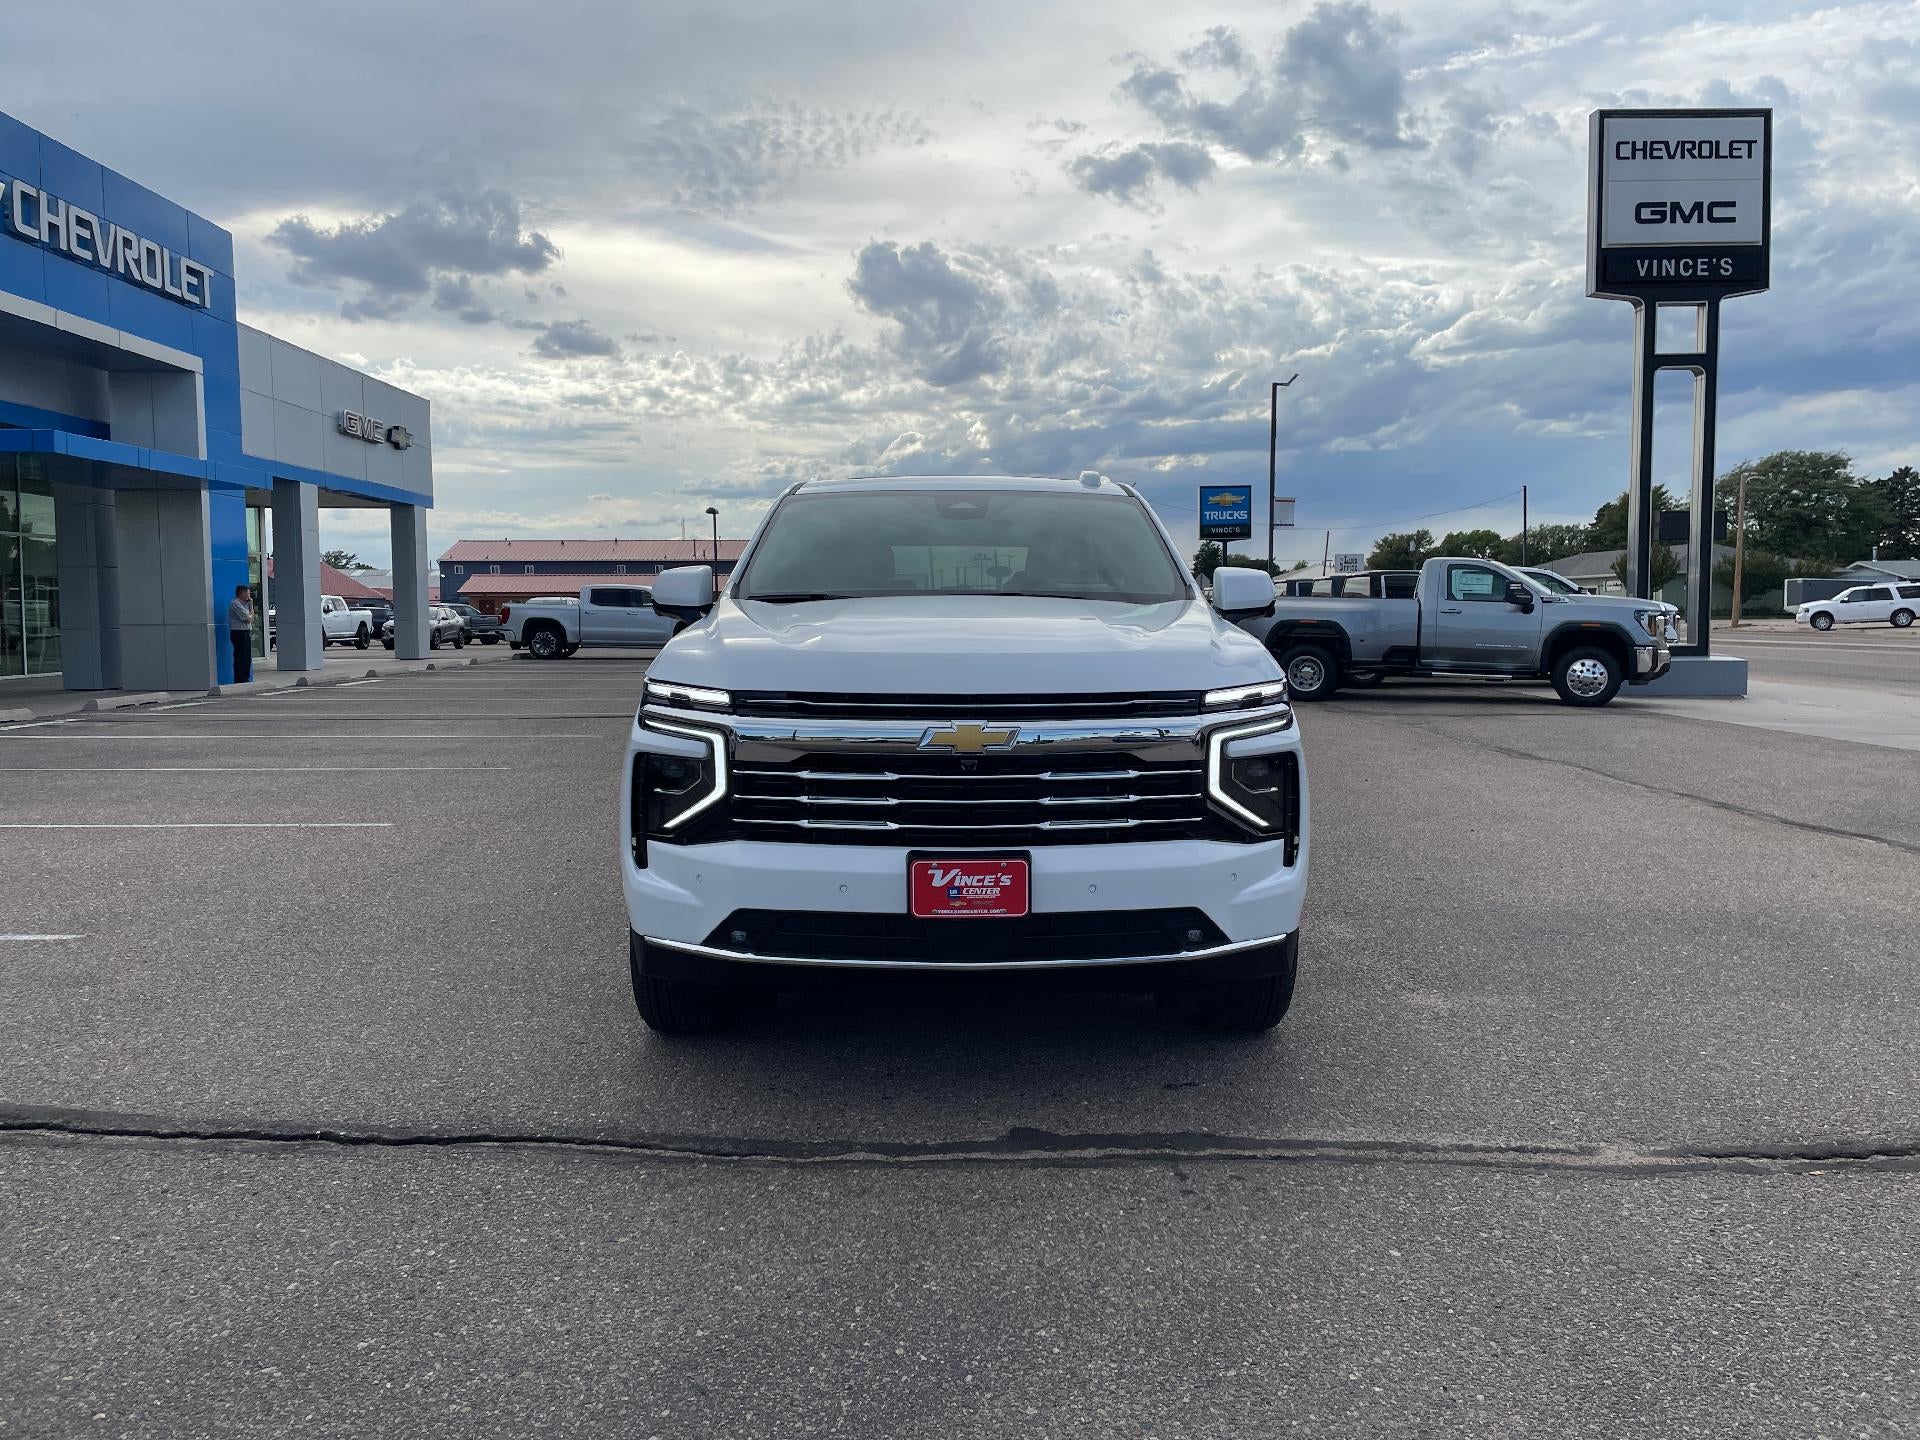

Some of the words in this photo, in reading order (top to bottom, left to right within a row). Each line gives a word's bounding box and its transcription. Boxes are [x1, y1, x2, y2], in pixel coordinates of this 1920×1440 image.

[1615, 139, 1758, 161] CHEVROLET
[1634, 200, 1737, 225] GMC
[12, 179, 215, 309] CHEVROLET
[1636, 257, 1733, 277] VINCE'S
[342, 409, 385, 444] GMC
[1204, 510, 1248, 521] TRUCKS
[962, 887, 1001, 896] CENTER
